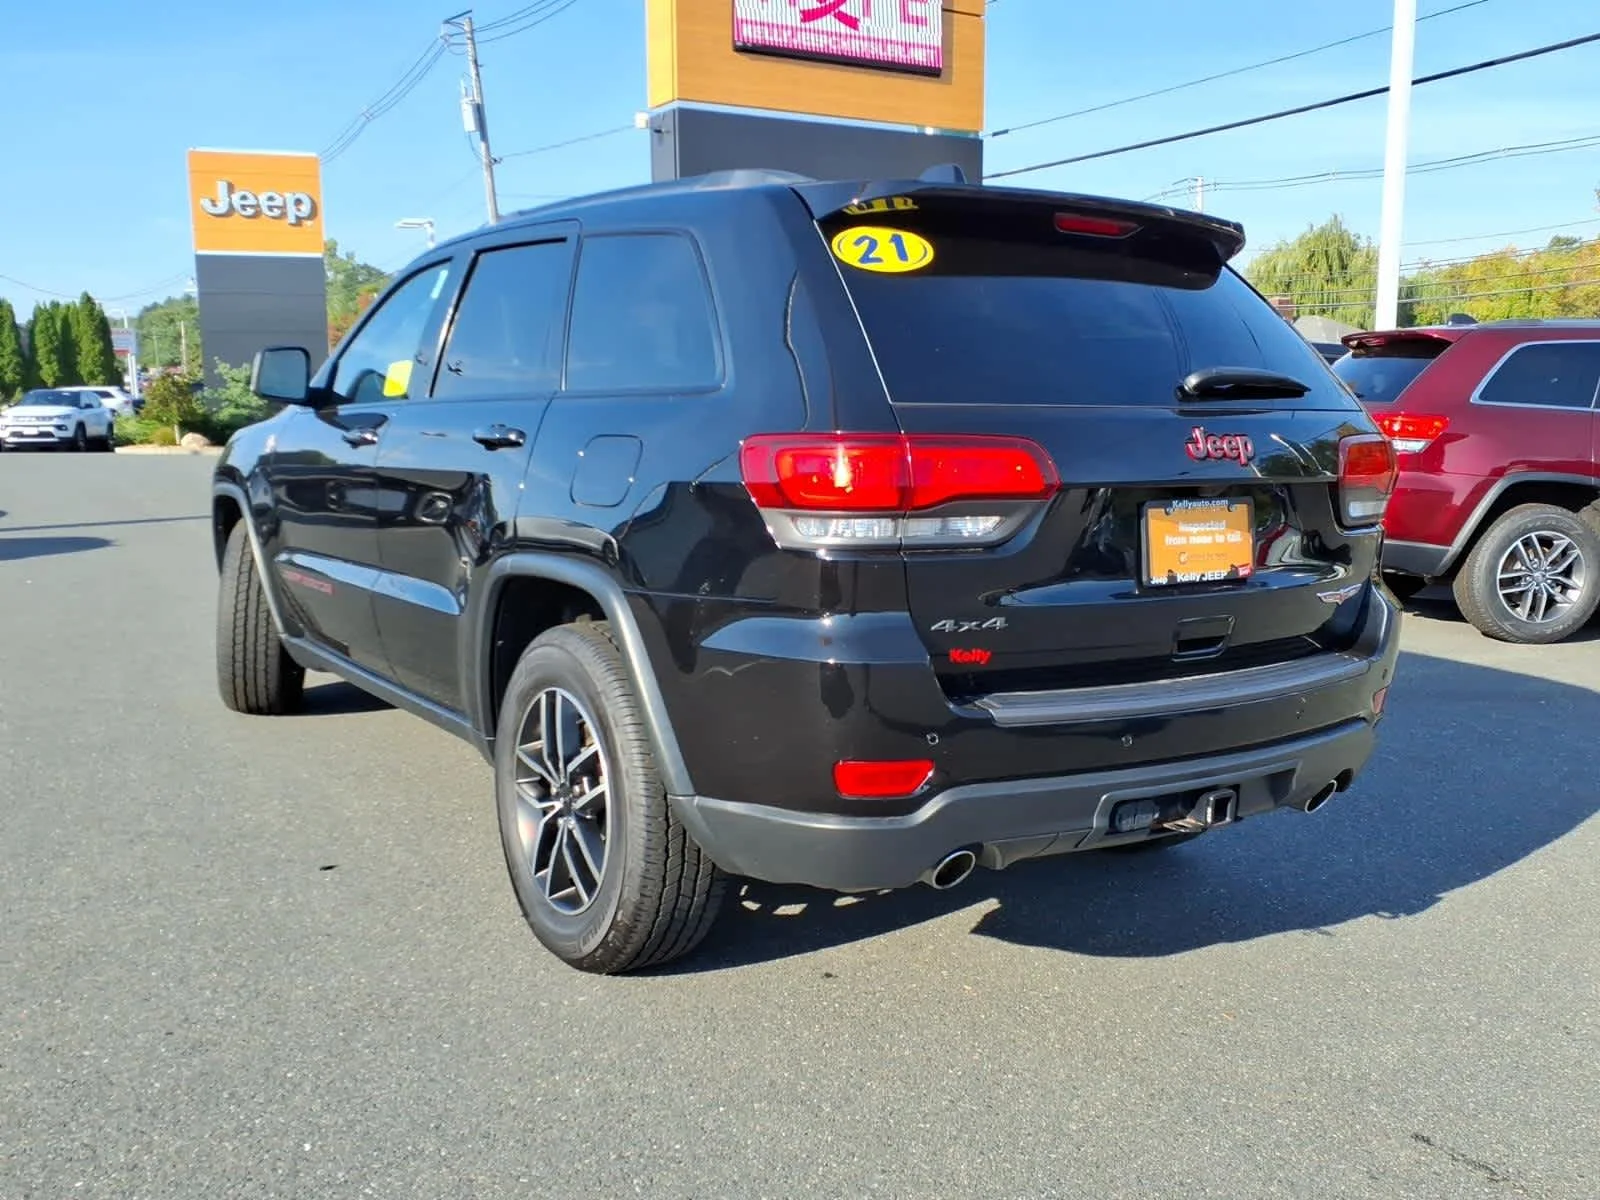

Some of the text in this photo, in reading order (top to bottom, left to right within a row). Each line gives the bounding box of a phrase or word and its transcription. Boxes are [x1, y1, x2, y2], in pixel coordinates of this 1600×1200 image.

[200, 179, 315, 226] Jeep
[853, 233, 909, 264] 21
[1186, 426, 1255, 466] Jeep
[1172, 500, 1229, 508] Kellyauto.com
[1177, 572, 1201, 583] Kelly
[1202, 570, 1228, 581] JEEP
[930, 616, 1008, 632] 4x4
[949, 648, 991, 665] Kelly
